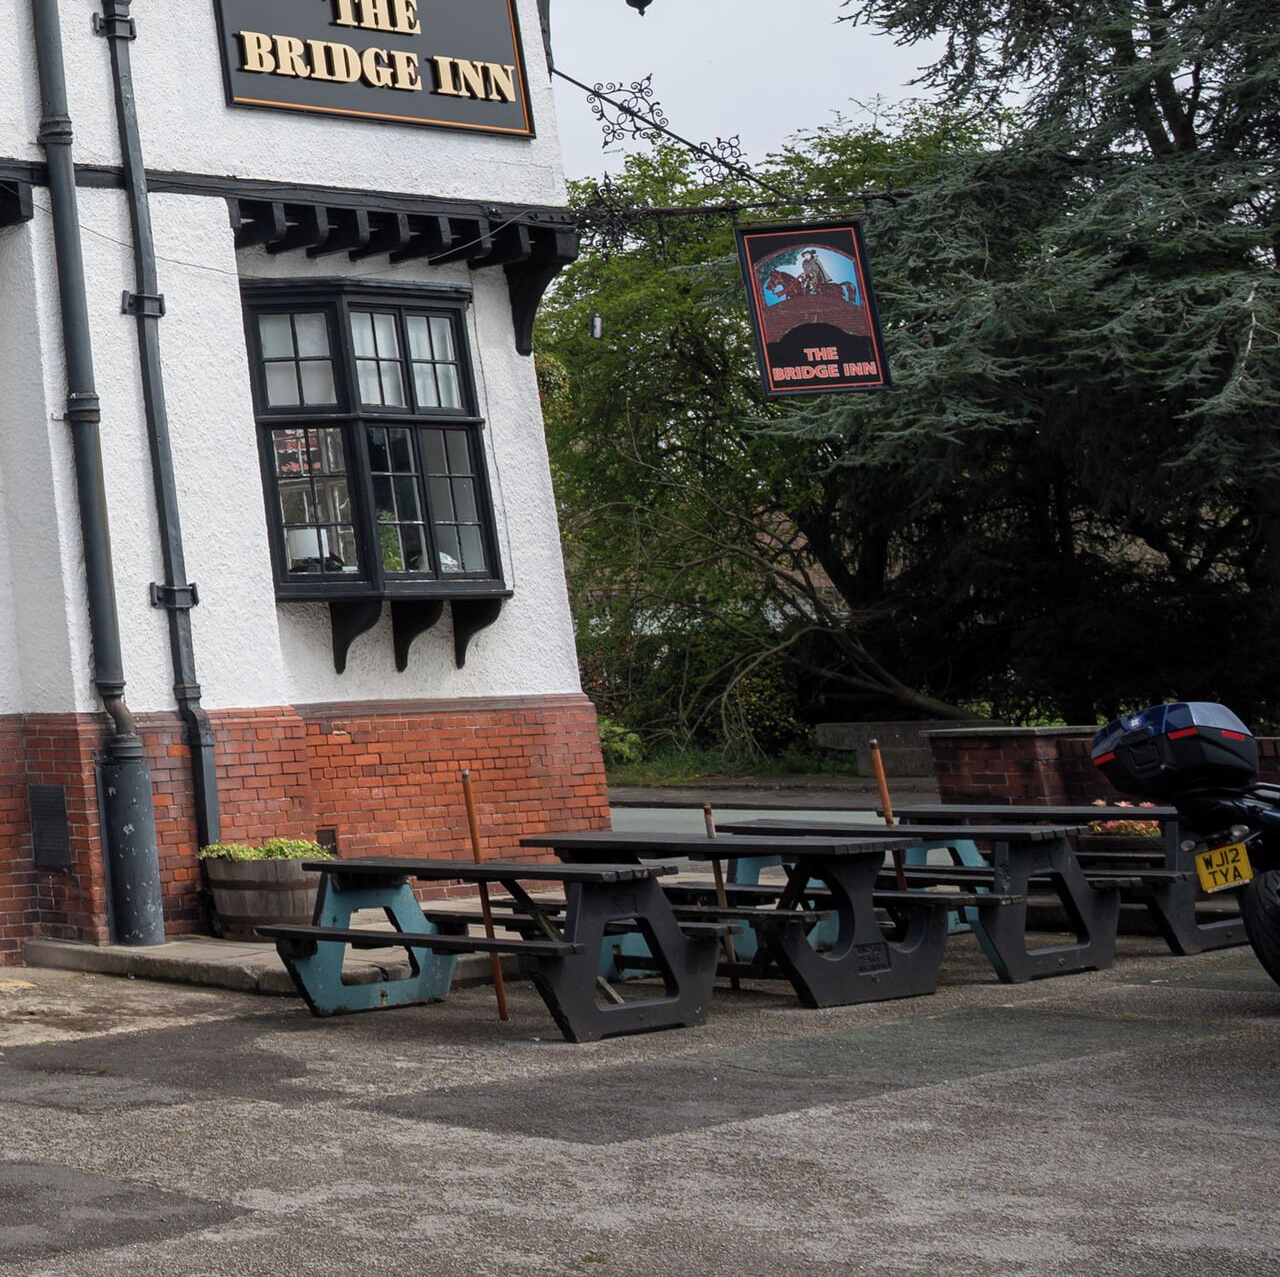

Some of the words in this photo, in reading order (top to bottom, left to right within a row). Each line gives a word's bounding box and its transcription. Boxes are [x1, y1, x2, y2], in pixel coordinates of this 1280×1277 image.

[240, 30, 423, 91] BRIDGE
[433, 55, 516, 102] INN
[803, 346, 839, 361] THE
[772, 363, 840, 381] BRIDGE
[842, 361, 878, 377] INN
[1202, 848, 1241, 870] WJ12
[1208, 865, 1243, 885] TYA
